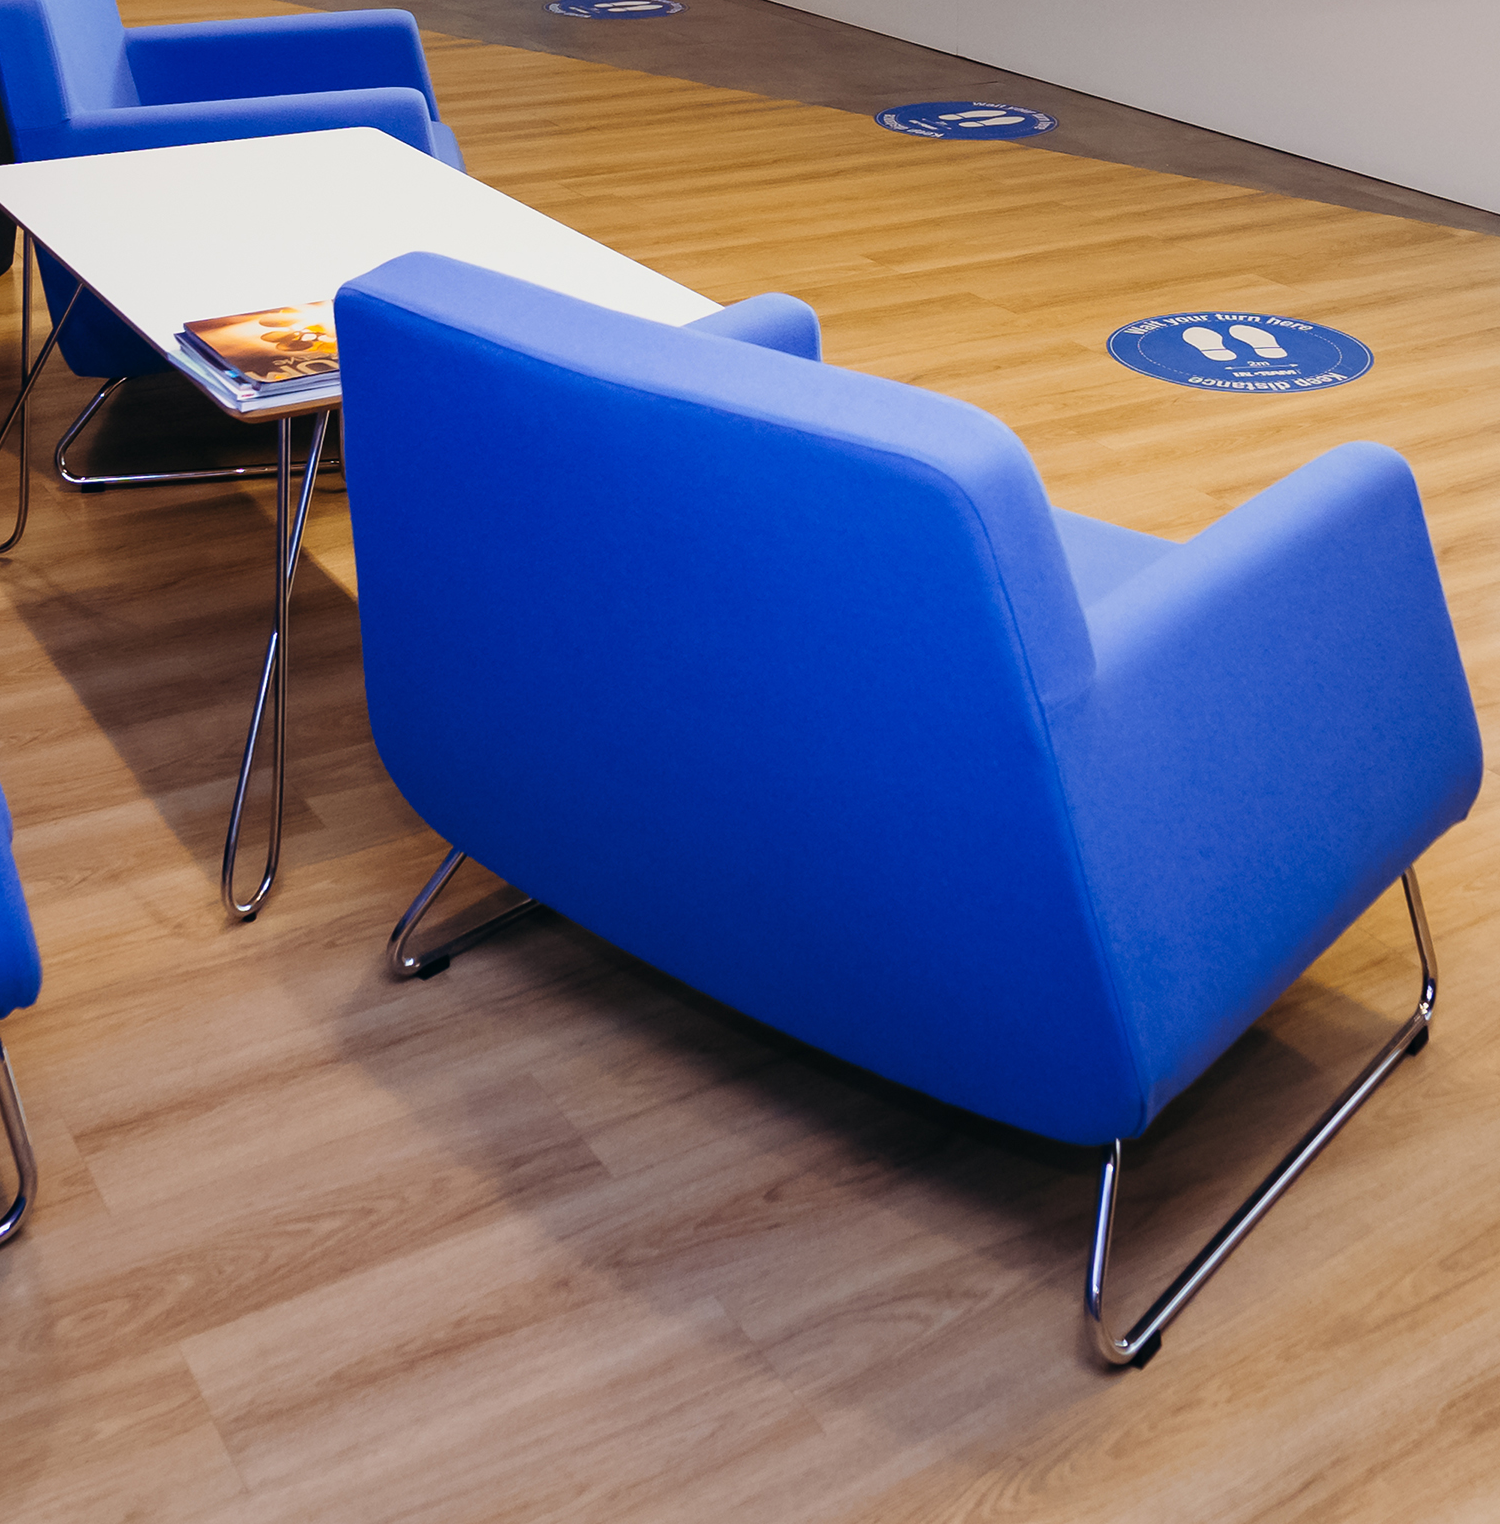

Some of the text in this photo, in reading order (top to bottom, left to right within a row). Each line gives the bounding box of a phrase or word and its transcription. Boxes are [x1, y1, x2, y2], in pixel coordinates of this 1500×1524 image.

[1124, 313, 1314, 335] Wait your turn here
[1187, 372, 1348, 391] Keep distance
